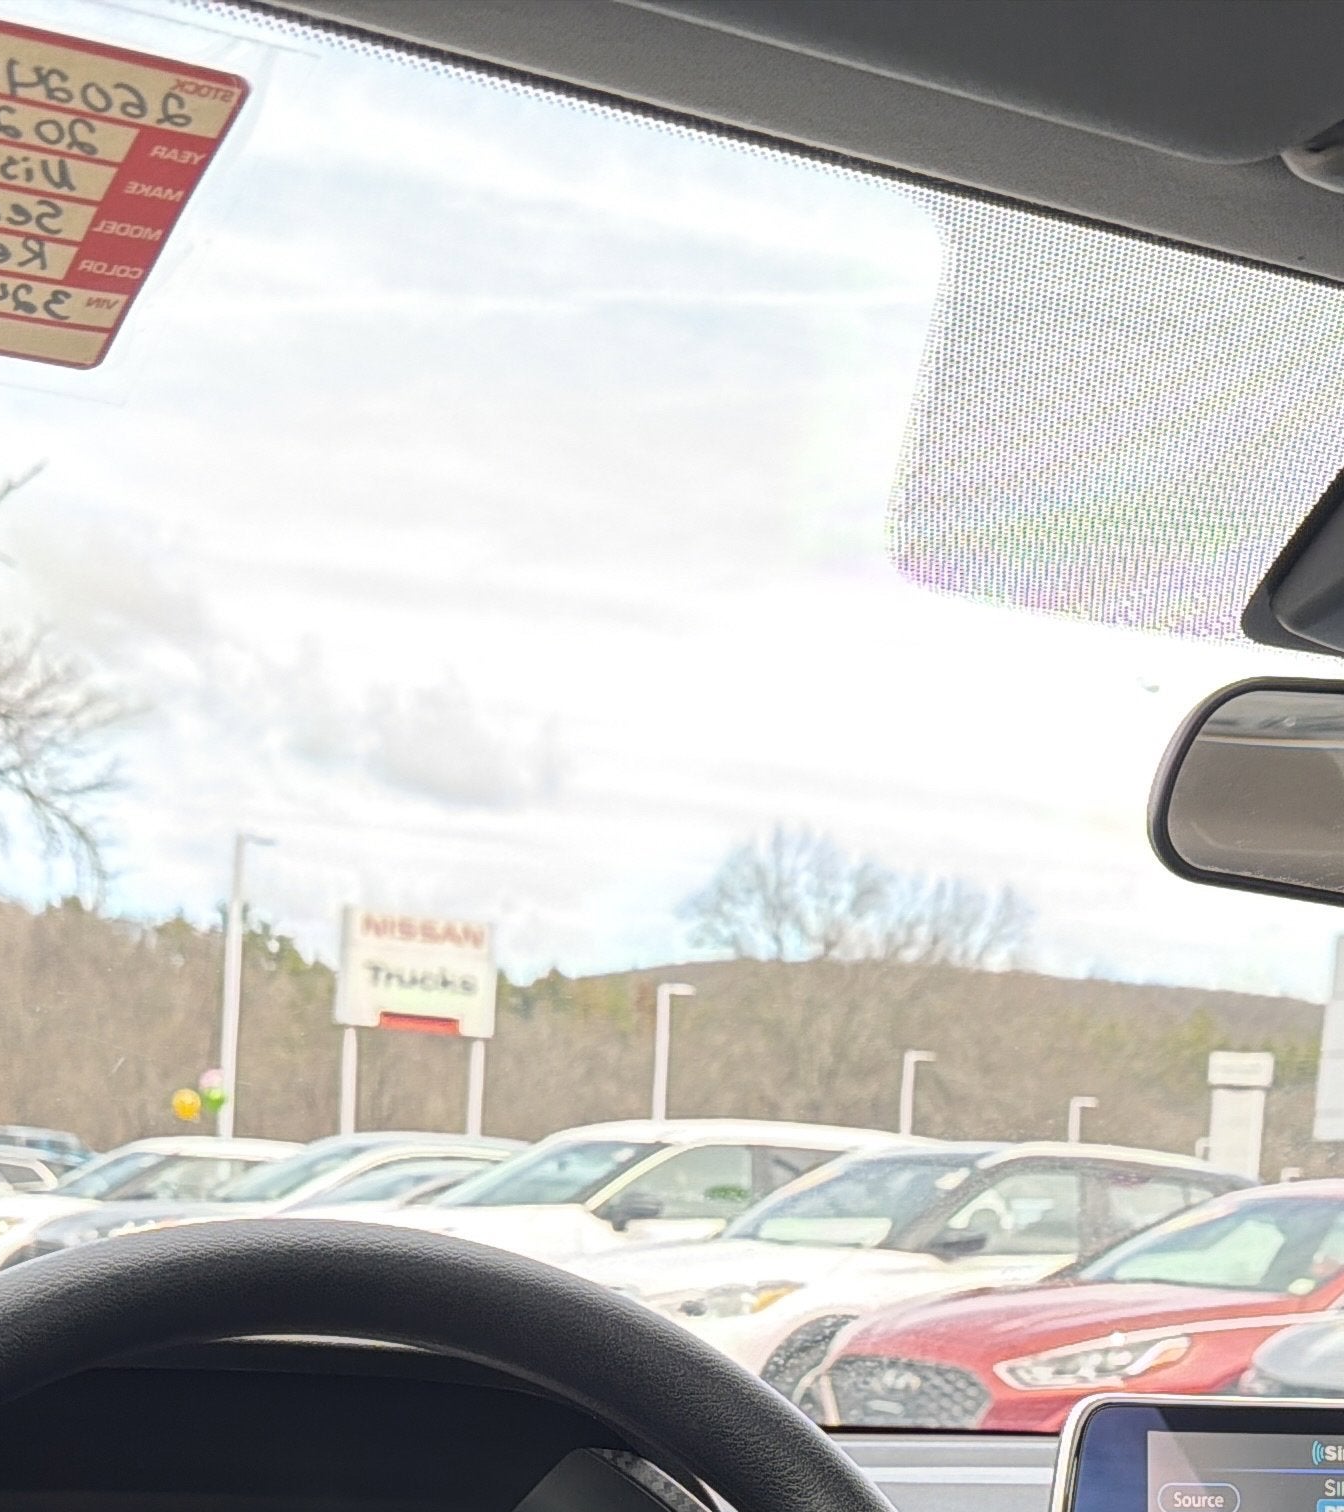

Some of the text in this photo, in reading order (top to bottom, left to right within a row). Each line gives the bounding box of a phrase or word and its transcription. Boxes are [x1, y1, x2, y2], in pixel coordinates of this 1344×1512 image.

[362, 912, 486, 949] NISSAN
[368, 960, 479, 994] Trucks
[1173, 1491, 1225, 1508] Source
